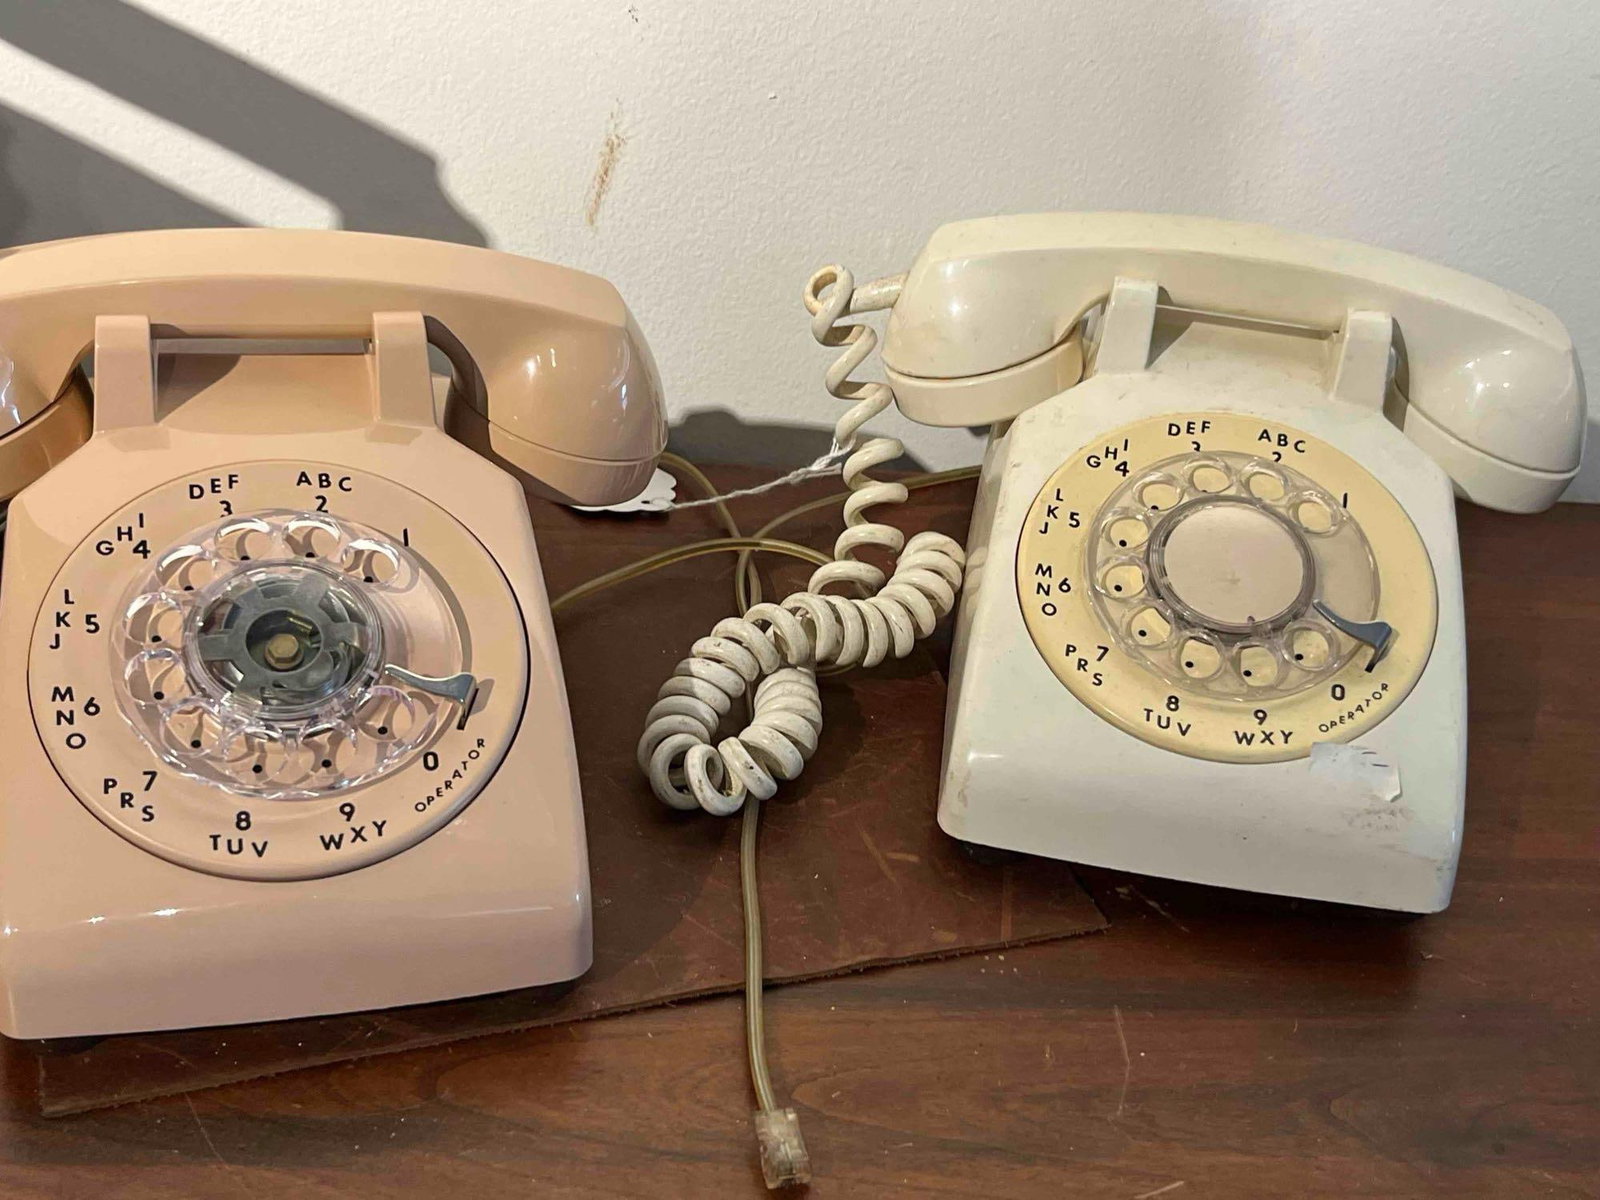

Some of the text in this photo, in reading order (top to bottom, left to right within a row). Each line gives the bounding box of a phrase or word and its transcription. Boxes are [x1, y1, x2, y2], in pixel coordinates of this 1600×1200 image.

[1168, 420, 1211, 436] DEF
[1258, 429, 1306, 454] ABC
[1115, 461, 1129, 477] 4
[189, 474, 238, 501] DEF
[297, 471, 352, 492] ABC
[219, 500, 233, 517] 3
[315, 495, 328, 513] 2
[1069, 512, 1080, 528] 5
[132, 539, 151, 559] 4
[1058, 577, 1071, 593] 6
[85, 614, 100, 634] 5
[1097, 645, 1109, 661] 7
[1331, 684, 1345, 701] 0
[84, 697, 100, 716] 6
[1166, 695, 1179, 712] 8
[1319, 682, 1389, 733] OPERATOR
[1144, 708, 1191, 736] TUV
[1254, 709, 1267, 725] 9
[1234, 730, 1293, 746] WXY
[420, 749, 439, 771] 0
[143, 771, 157, 791] 7
[414, 738, 486, 813] OPERATOR
[236, 811, 251, 831] 8
[339, 803, 355, 822] 9
[320, 820, 387, 850] WXY
[209, 834, 268, 857] TUV
